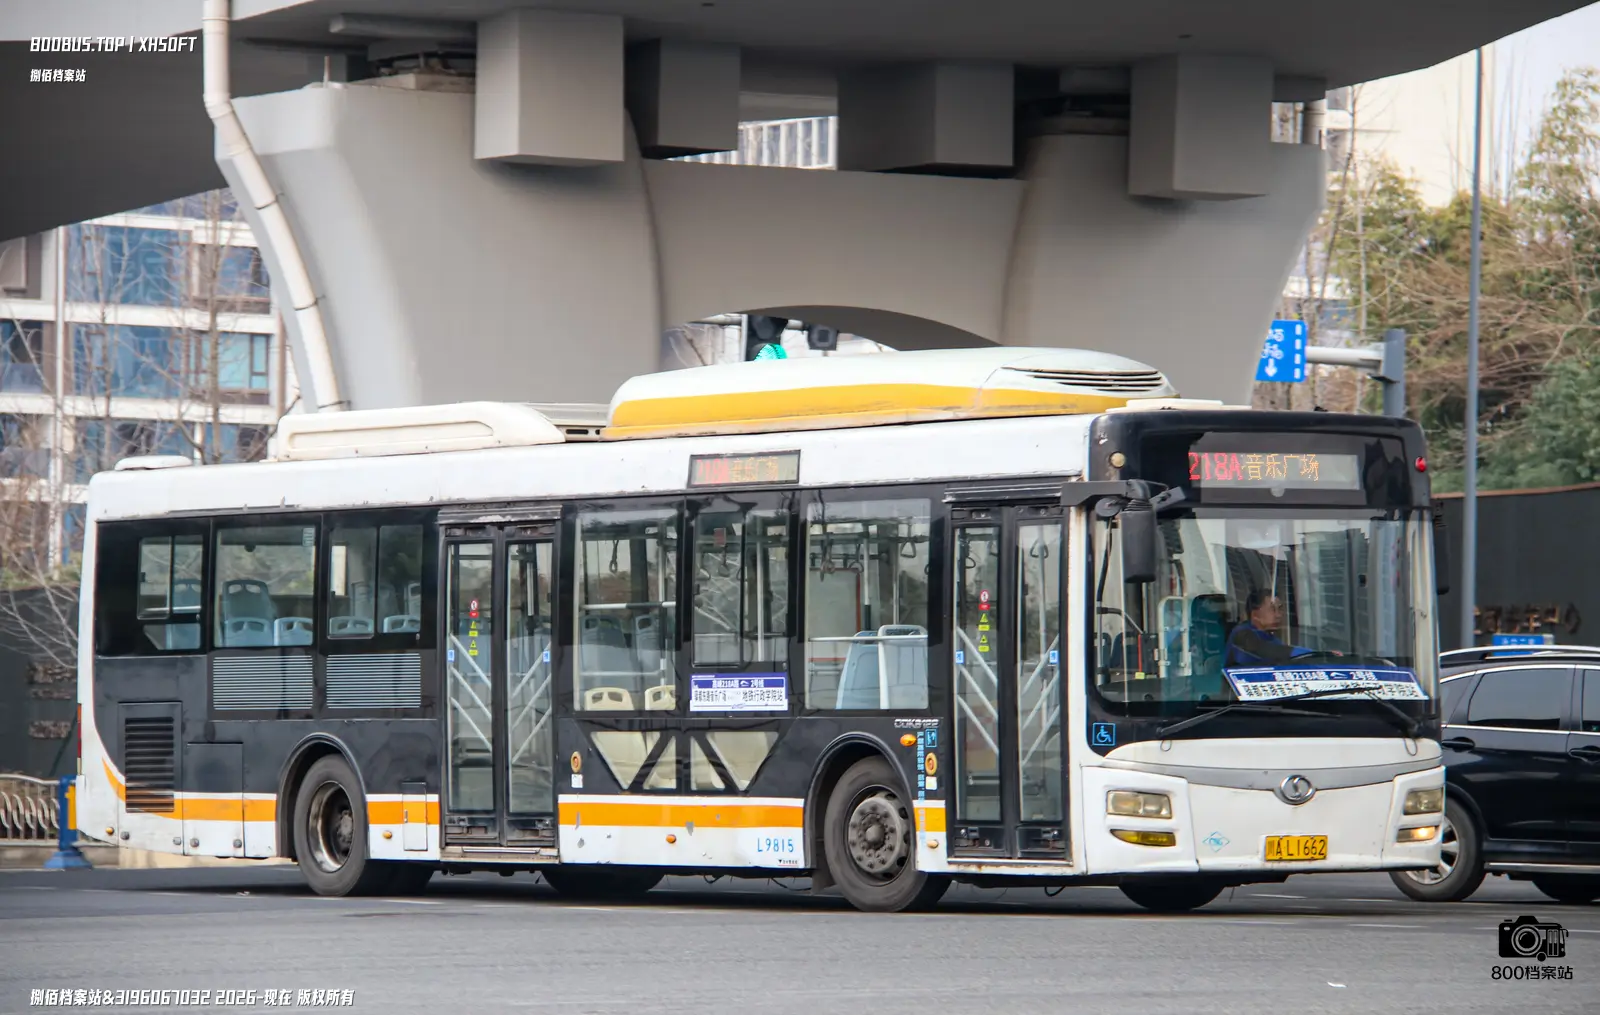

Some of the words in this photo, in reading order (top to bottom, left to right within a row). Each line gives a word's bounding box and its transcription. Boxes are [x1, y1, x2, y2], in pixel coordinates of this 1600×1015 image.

[1188, 452, 1243, 480] 218A
[1244, 453, 1320, 481] 音乐广场
[757, 838, 794, 853] L9815
